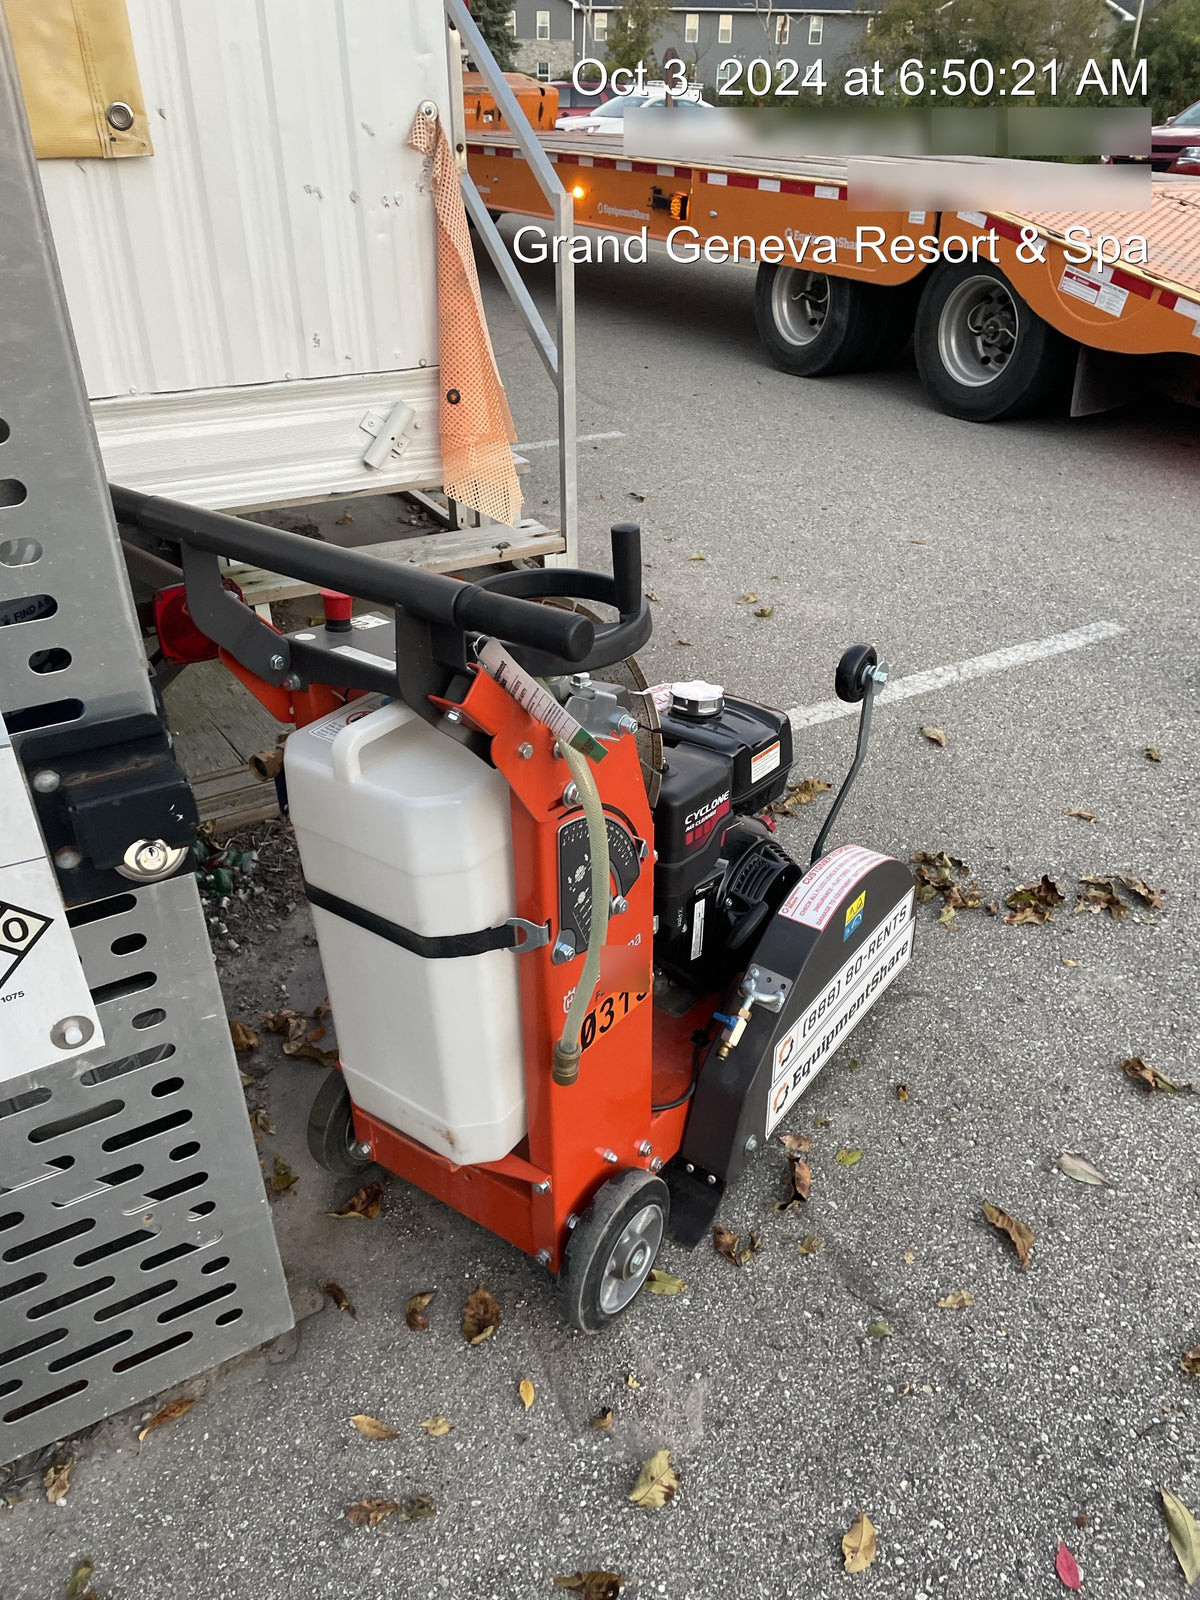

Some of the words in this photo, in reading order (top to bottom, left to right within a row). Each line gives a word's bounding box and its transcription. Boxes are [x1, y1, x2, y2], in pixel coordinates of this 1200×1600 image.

[684, 789, 730, 825] CYCLONE
[694, 809, 717, 827] CLEANER
[802, 856, 832, 885] CUSTOMER
[801, 979, 842, 1039] (888)
[845, 903, 908, 987] 80-RENTS
[791, 940, 909, 1092] EquipmentShare
